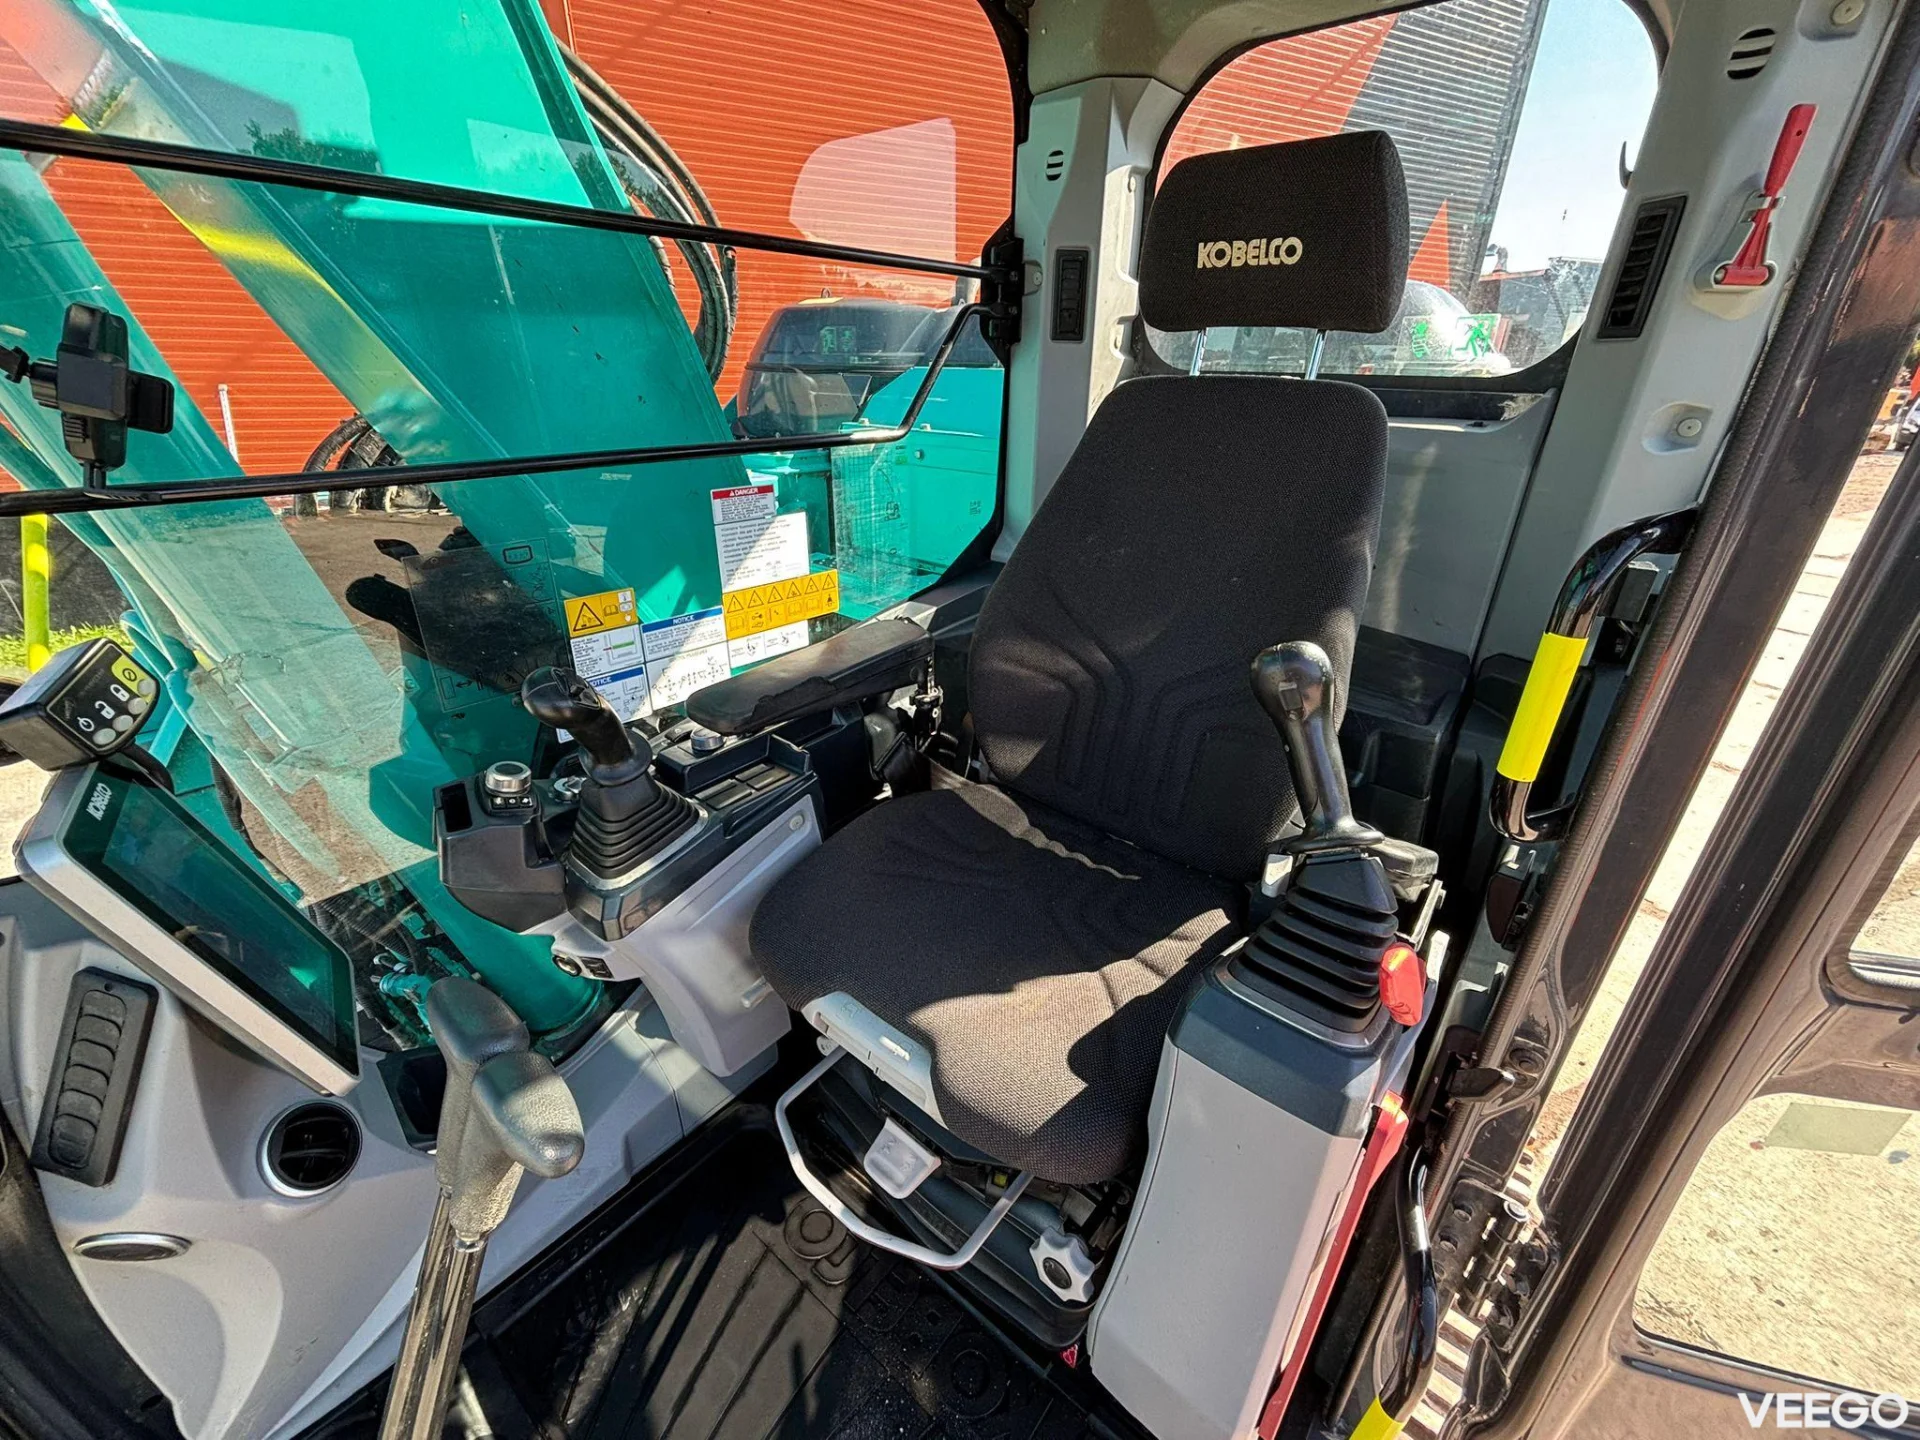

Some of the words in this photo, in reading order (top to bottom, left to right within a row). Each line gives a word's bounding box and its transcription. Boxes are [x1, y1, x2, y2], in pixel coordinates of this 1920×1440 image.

[1197, 236, 1303, 269] KOBELCO
[734, 487, 759, 496] DANGER
[672, 614, 695, 625] NOTICE
[85, 782, 113, 821] KOBELCO
